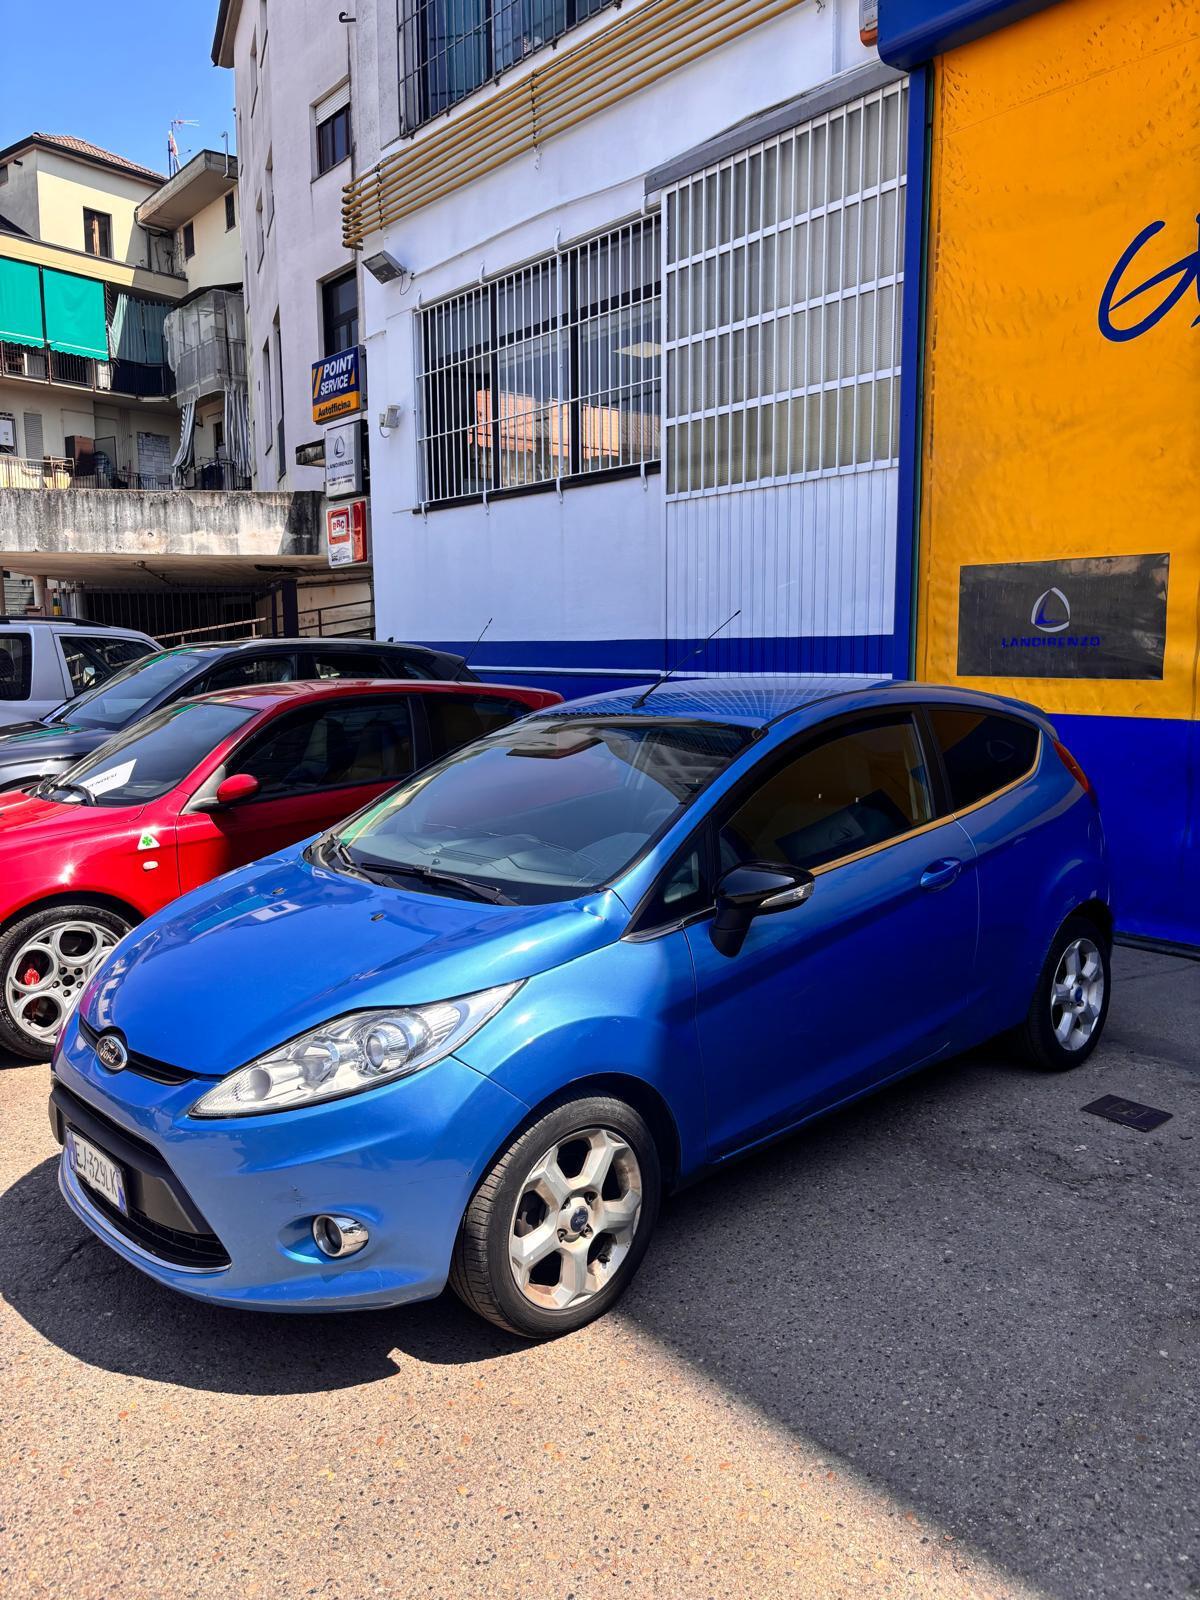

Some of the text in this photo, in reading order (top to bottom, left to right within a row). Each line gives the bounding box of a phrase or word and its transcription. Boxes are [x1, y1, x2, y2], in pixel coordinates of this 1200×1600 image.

[323, 354, 354, 379] POINT
[320, 374, 349, 396] SERVICE
[318, 400, 351, 417] Autofficina
[1001, 637, 1101, 648] LANDIRENZO
